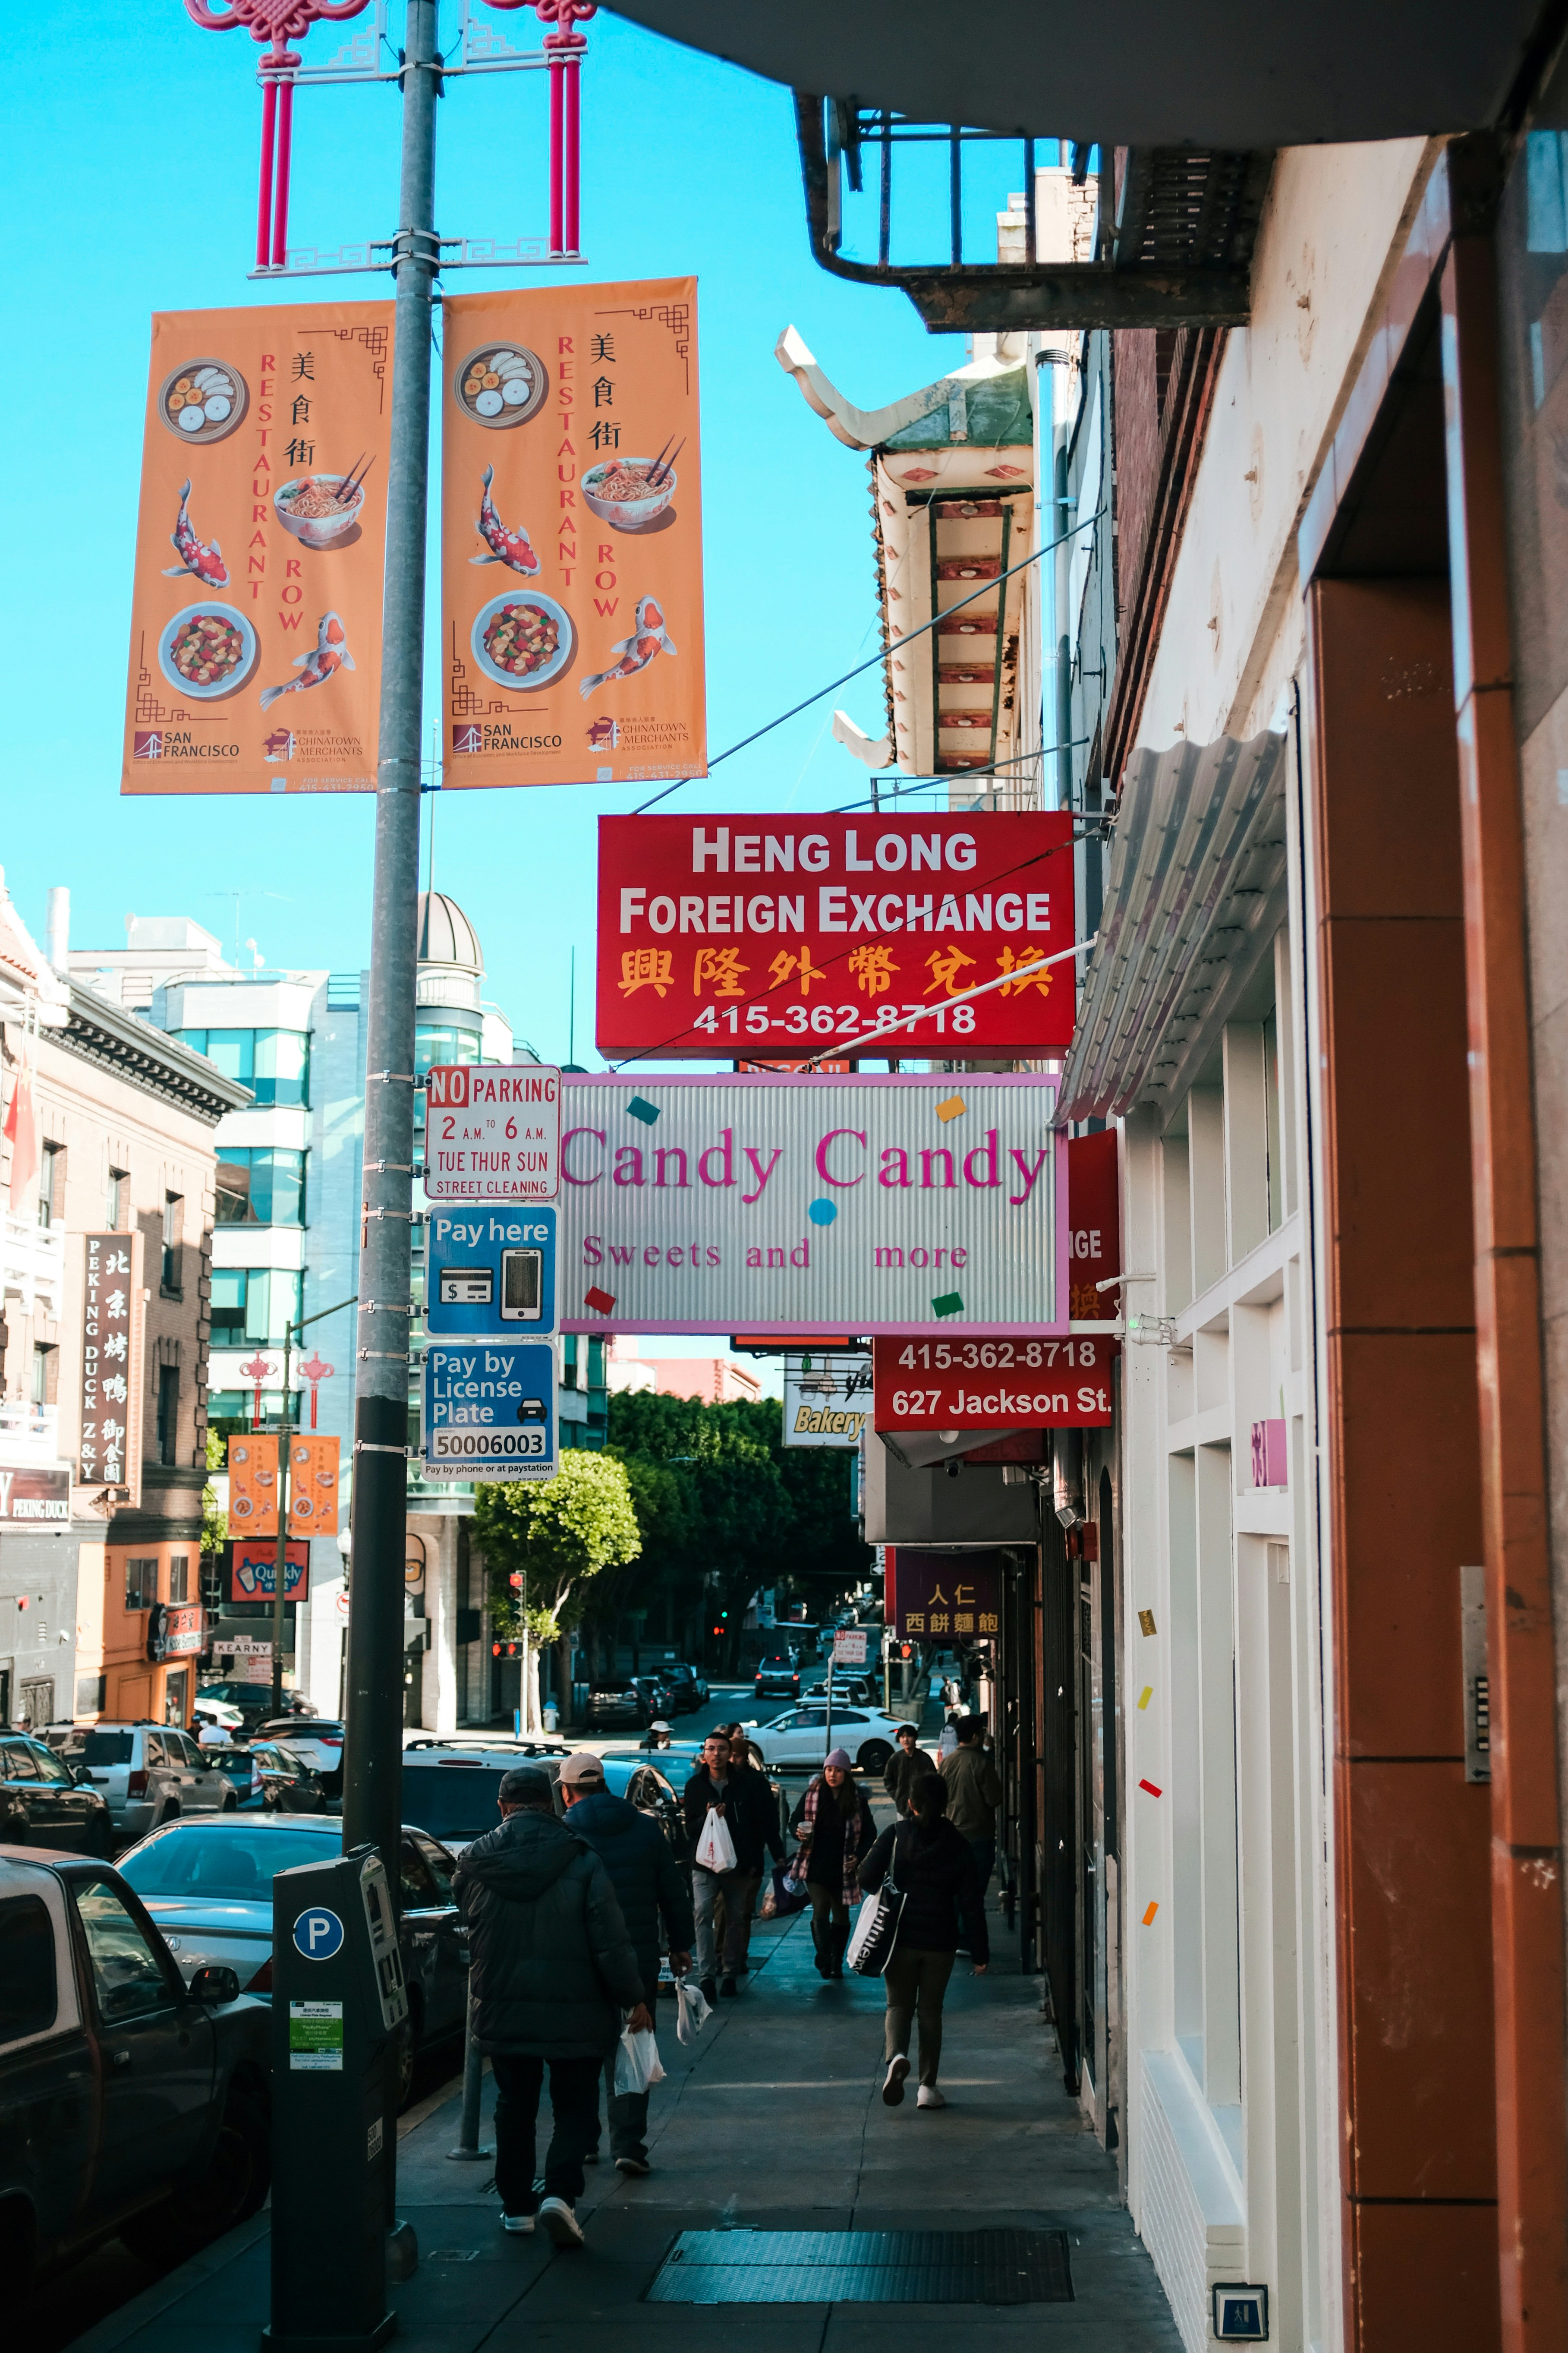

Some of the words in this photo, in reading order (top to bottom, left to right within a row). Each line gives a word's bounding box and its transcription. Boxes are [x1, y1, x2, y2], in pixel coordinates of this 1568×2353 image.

[587, 333, 621, 450] 美食街
[282, 351, 316, 467] 美食街
[557, 336, 577, 586] RESTAURANT
[247, 354, 276, 599] RESTAURANT
[593, 544, 619, 617] ROW
[278, 559, 304, 631] ROW
[164, 732, 192, 744] SAN
[484, 724, 511, 736] SAN
[623, 722, 686, 734] CHINATOWN
[625, 732, 689, 744] MERCHANTS
[164, 744, 239, 757] FRANCISCO
[299, 736, 361, 746] CHINATOWN
[300, 747, 363, 755] MERCHANTS
[484, 735, 562, 750] FRANCISCO
[626, 769, 703, 780] 415-431-2950
[299, 783, 374, 792] 415-431-2950
[693, 827, 830, 872] HENG
[845, 830, 977, 872] LONG
[620, 887, 804, 934] FOREIGN
[819, 886, 1051, 932] EXCHANGE
[693, 1005, 976, 1034] 415-362-8718
[431, 1070, 465, 1103] NO
[473, 1078, 555, 1102] PARKING
[442, 1116, 455, 1140] 2
[463, 1127, 485, 1140] A.M.
[486, 1120, 495, 1128] TO
[505, 1116, 517, 1139] 6
[525, 1127, 546, 1139] A.M.
[438, 1152, 465, 1171] TUE
[471, 1152, 510, 1171] THUR
[517, 1152, 548, 1172] SUN
[561, 1127, 783, 1204] Candy
[815, 1128, 1049, 1205] Candy
[437, 1181, 482, 1193] STREET
[487, 1181, 547, 1193] CLEANING
[436, 1219, 484, 1248] Pay
[489, 1218, 549, 1242] here
[583, 1236, 721, 1269] Sweets
[746, 1238, 810, 1269] and
[874, 1244, 968, 1269] more
[85, 1240, 101, 1336] PEKING
[433, 1353, 477, 1379] Pay
[485, 1350, 515, 1378] by
[899, 1341, 1096, 1369] 415-362-8718
[84, 1346, 99, 1409] DUCK
[434, 1376, 522, 1398] License
[433, 1401, 494, 1423] Plate
[892, 1390, 941, 1415] 627
[949, 1388, 1069, 1414] Jackson
[1077, 1387, 1112, 1413] St.
[794, 1405, 866, 1441] Bakery
[437, 1434, 543, 1455] 50006003
[425, 1466, 441, 1475] Pay
[443, 1465, 454, 1474] by
[456, 1464, 484, 1474] phone
[508, 1464, 553, 1473] paystation
[13, 1498, 45, 1518] PEKING
[45, 1500, 68, 1519] DUCK
[255, 1564, 302, 1583] Qukly
[836, 1631, 845, 1640] NO
[218, 1644, 268, 1653] KEARNY
[309, 1918, 330, 1950] P
